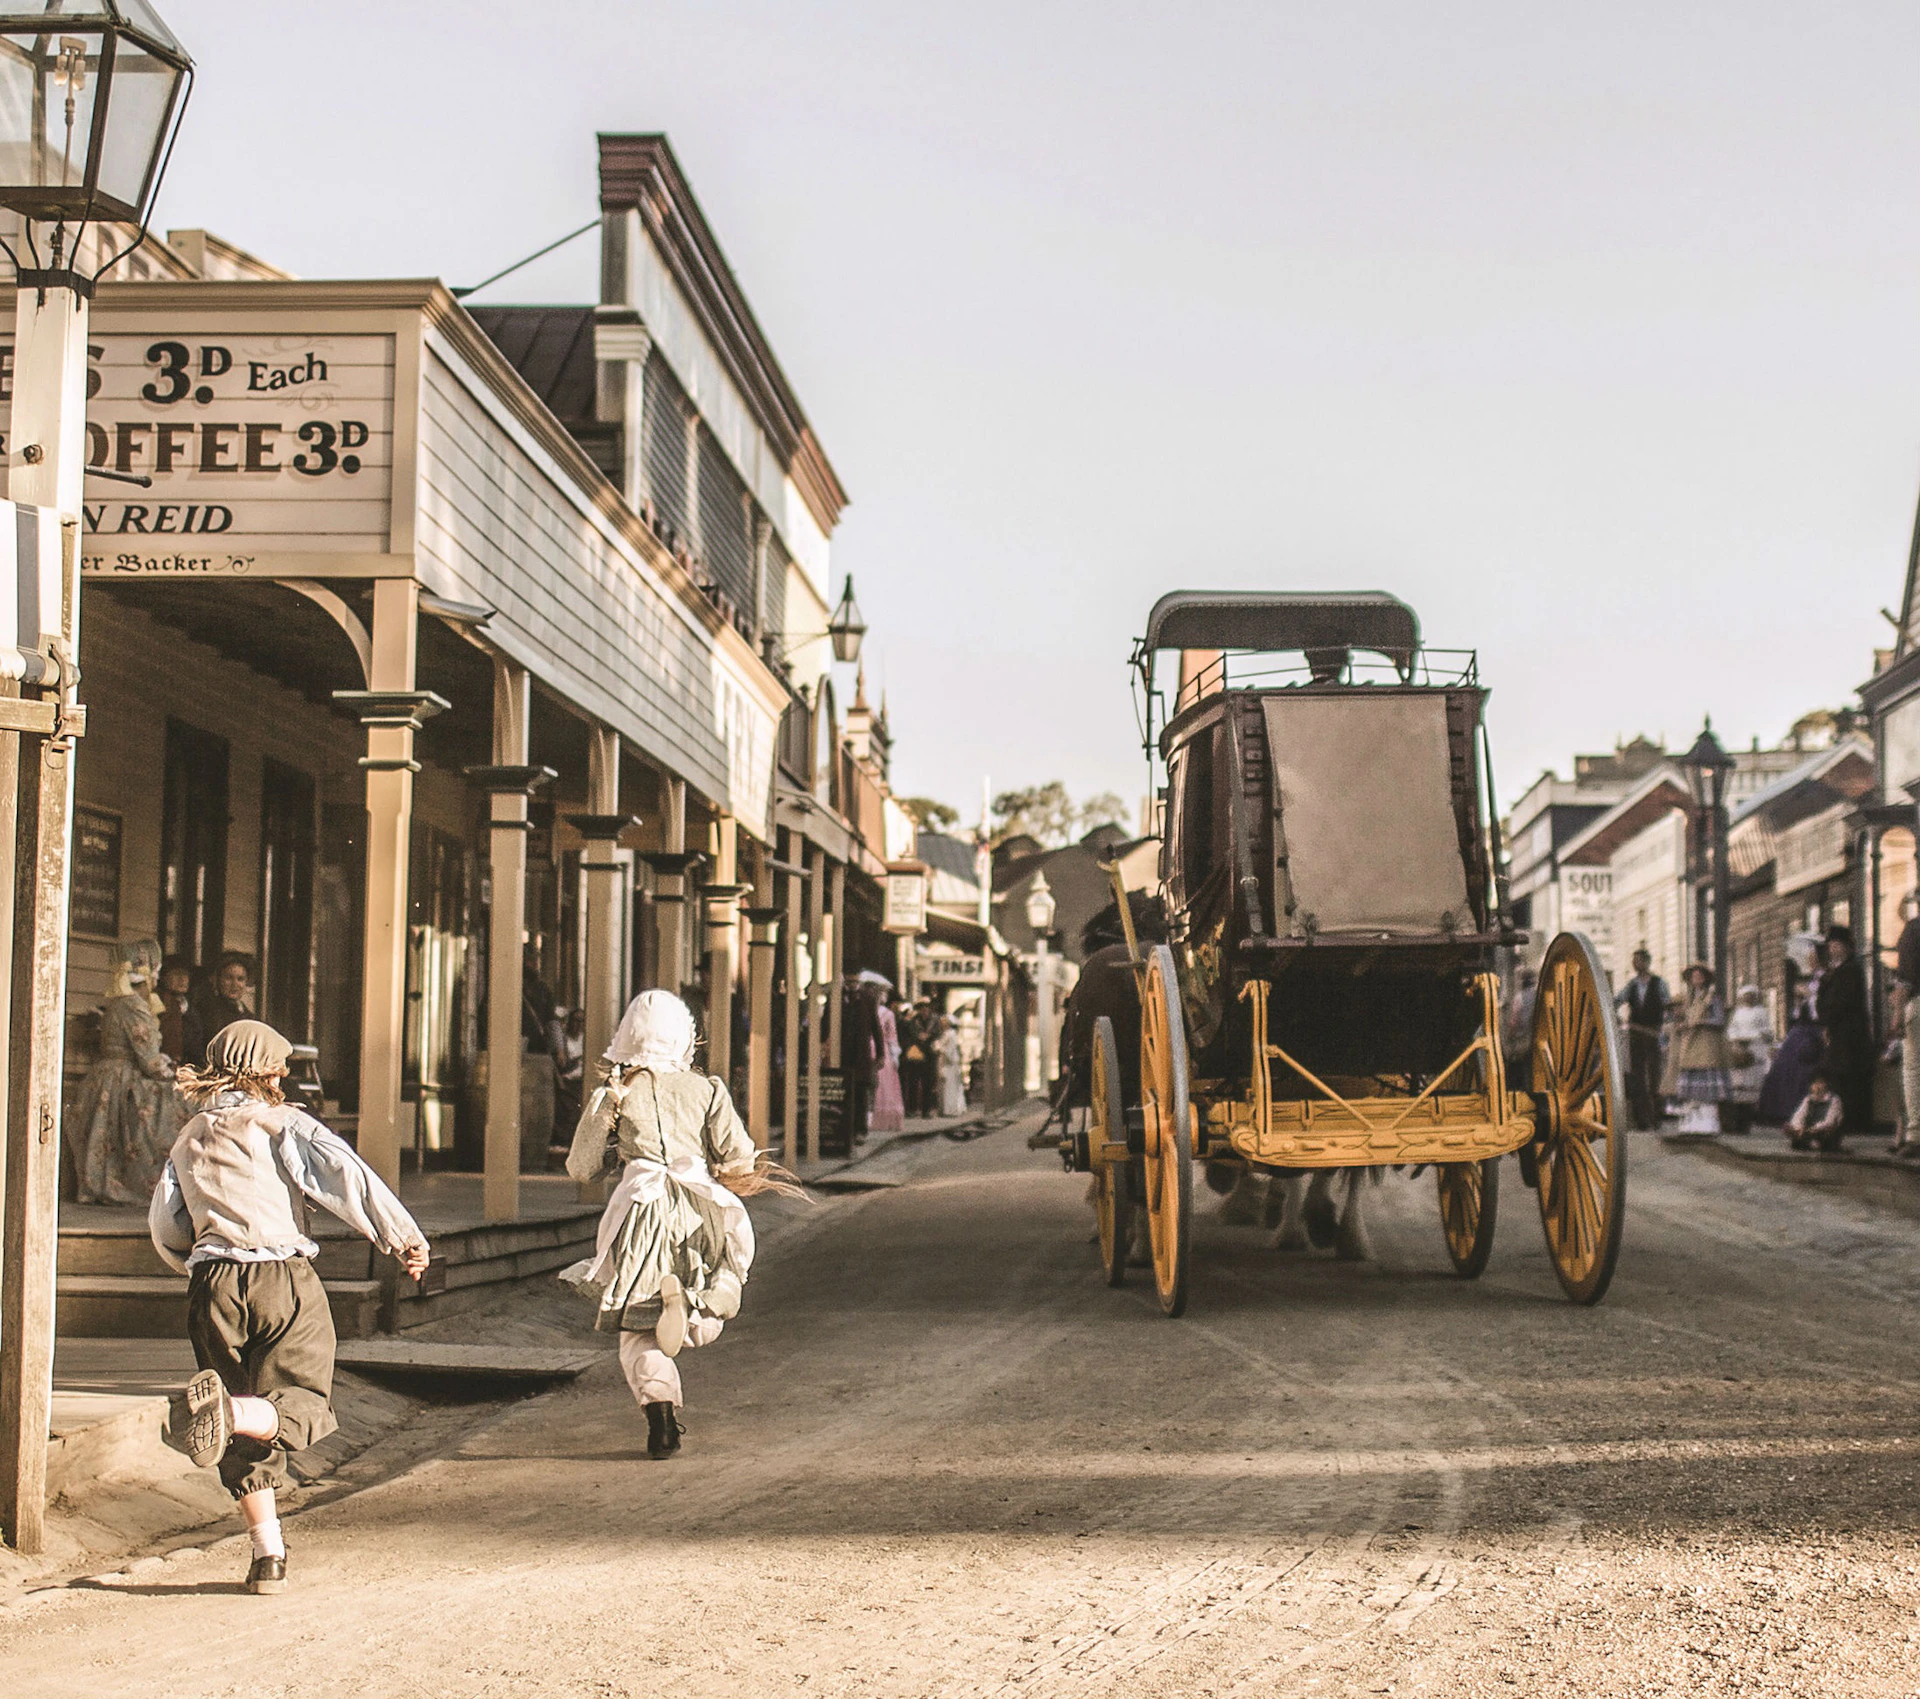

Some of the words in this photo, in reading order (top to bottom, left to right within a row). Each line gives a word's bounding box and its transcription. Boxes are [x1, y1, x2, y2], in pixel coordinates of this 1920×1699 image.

[247, 352, 328, 391] Each
[86, 422, 282, 473] OFFEE
[117, 505, 233, 533] REID
[82, 556, 104, 570] er
[114, 552, 212, 572] Backer
